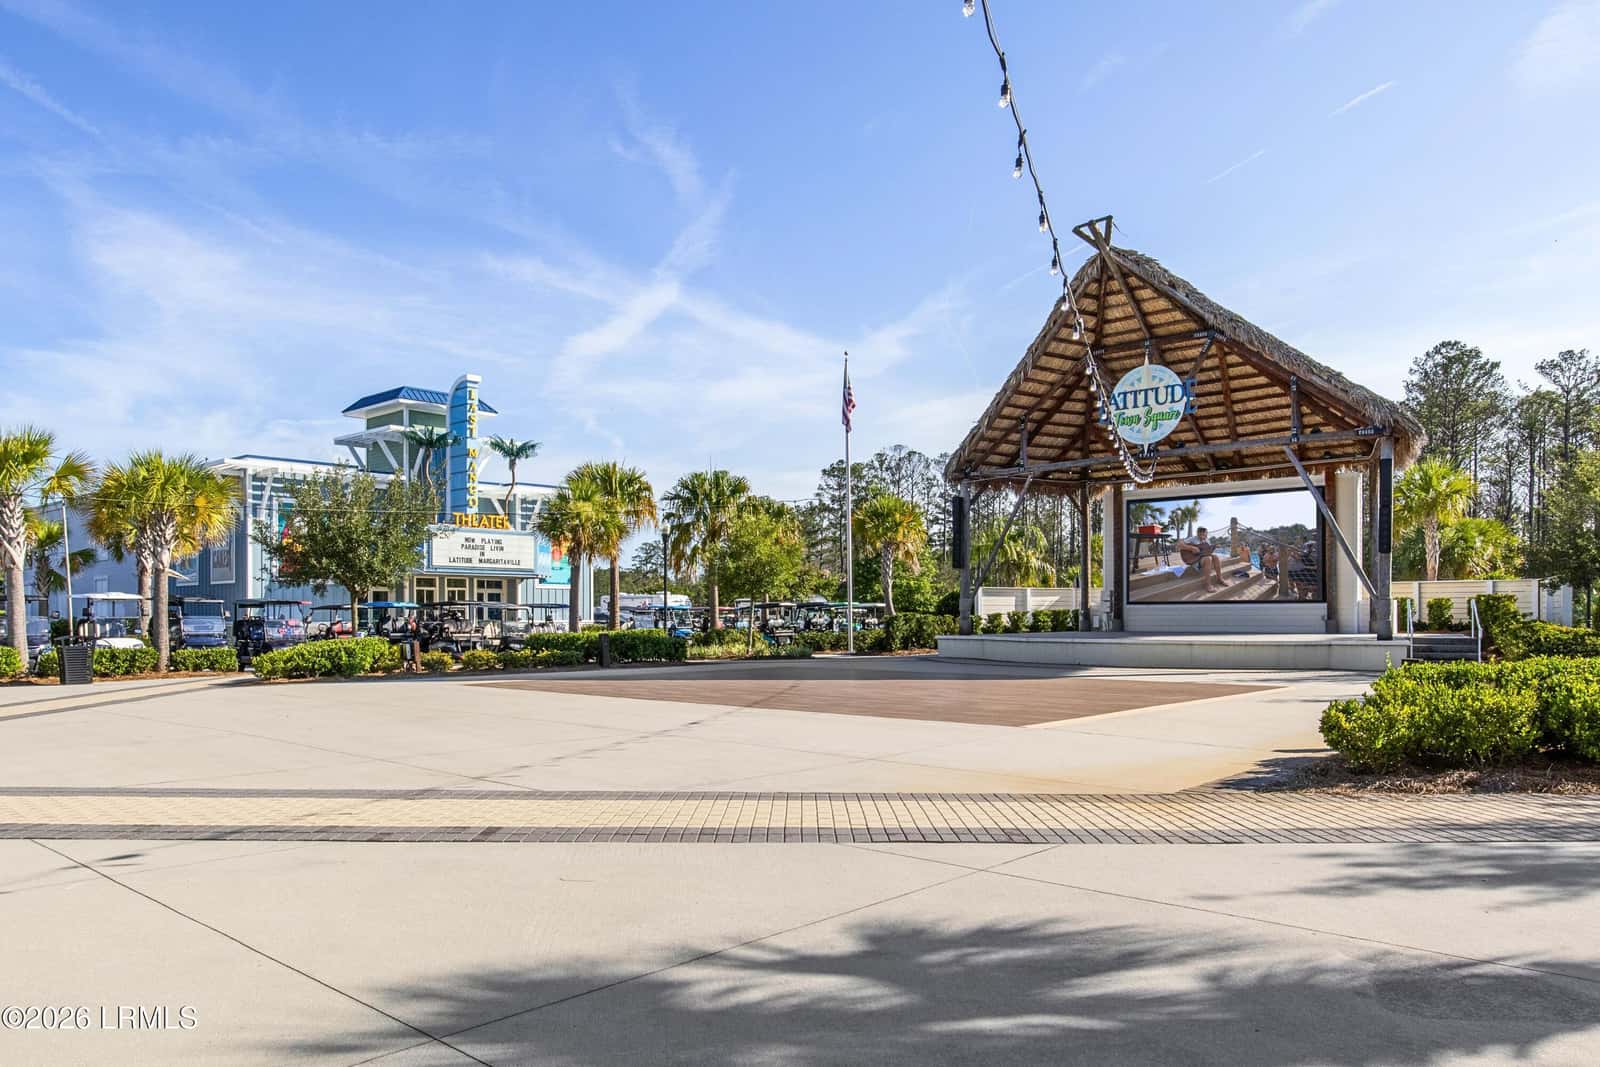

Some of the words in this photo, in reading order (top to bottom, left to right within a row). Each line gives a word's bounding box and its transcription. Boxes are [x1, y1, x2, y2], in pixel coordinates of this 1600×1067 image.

[468, 389, 478, 439] LAST
[1113, 411, 1141, 428] Town
[1144, 406, 1181, 430] Square
[468, 447, 479, 509] MANGO
[453, 512, 512, 530] THEATER
[461, 543, 486, 551] PARADISE
[481, 537, 503, 545] PLAYING
[478, 558, 521, 566] MARGARITAVILLE
